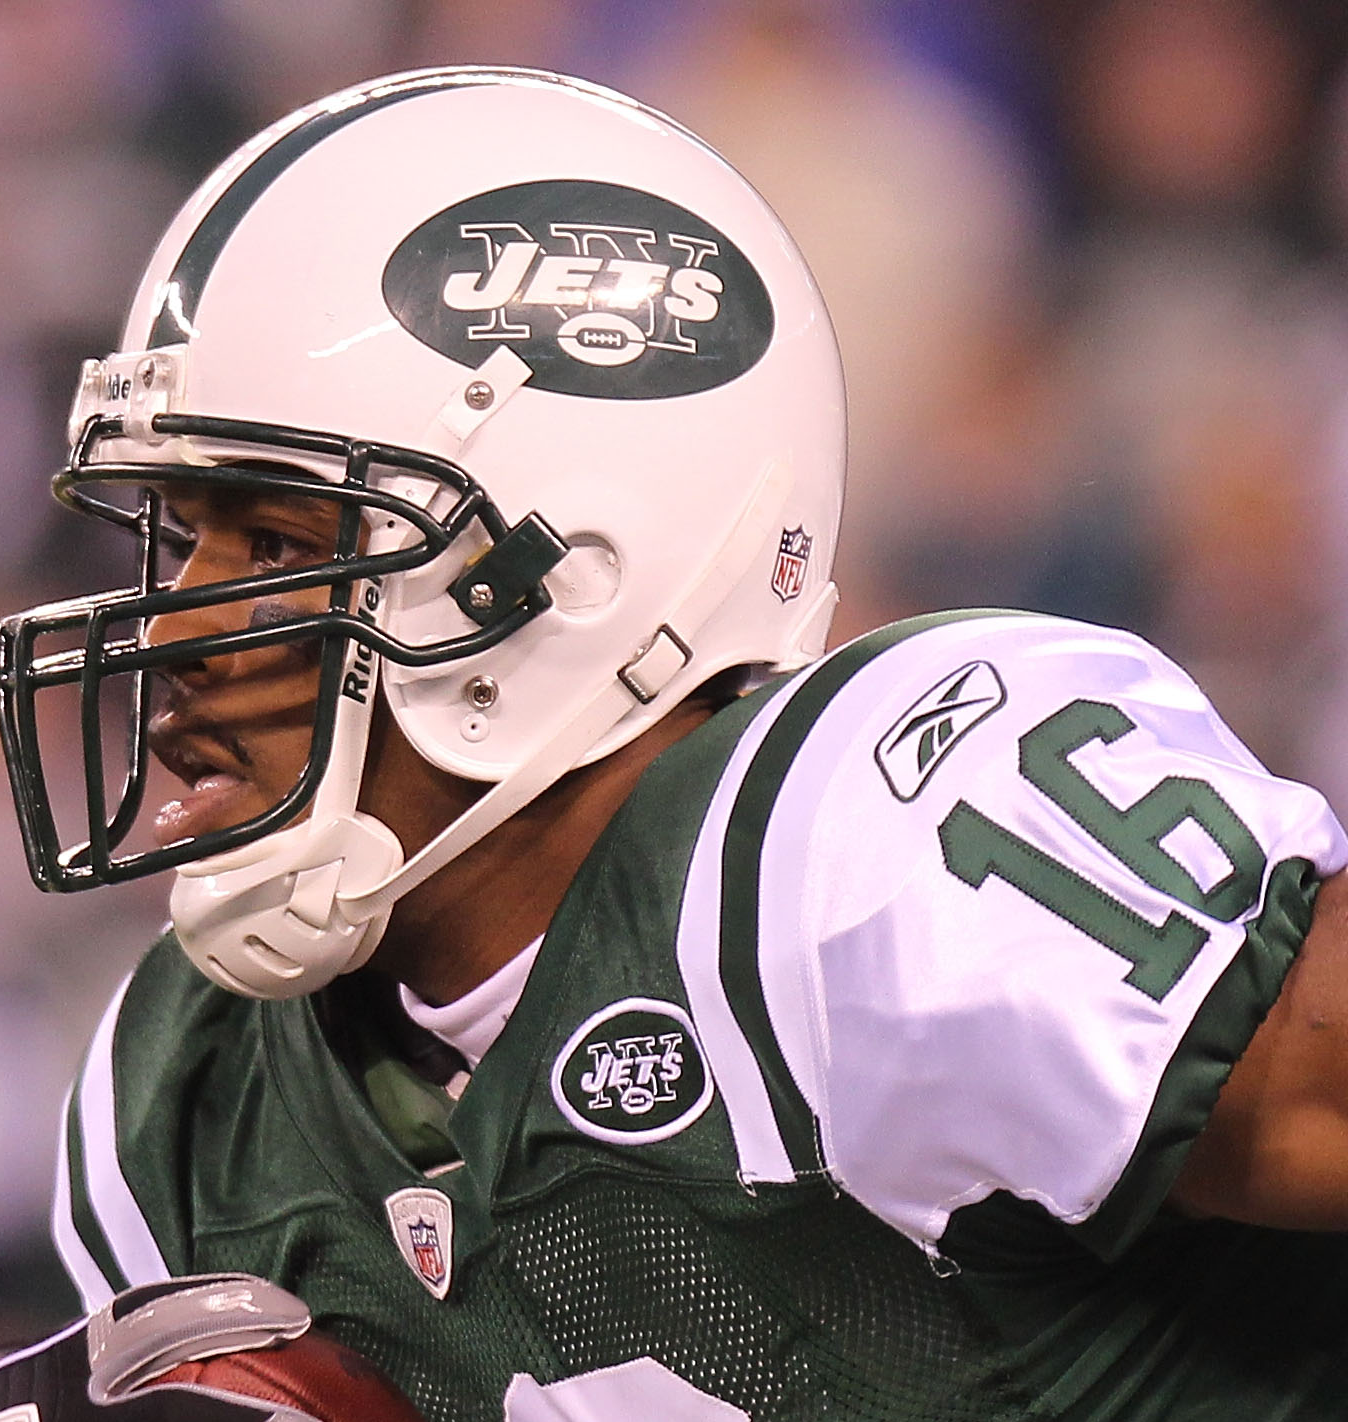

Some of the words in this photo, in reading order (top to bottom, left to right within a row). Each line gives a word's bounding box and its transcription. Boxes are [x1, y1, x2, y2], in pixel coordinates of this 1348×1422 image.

[443, 241, 724, 322] JETS
[774, 554, 803, 595] NFL
[937, 698, 1269, 1004] 16
[580, 1051, 684, 1094] JETS
